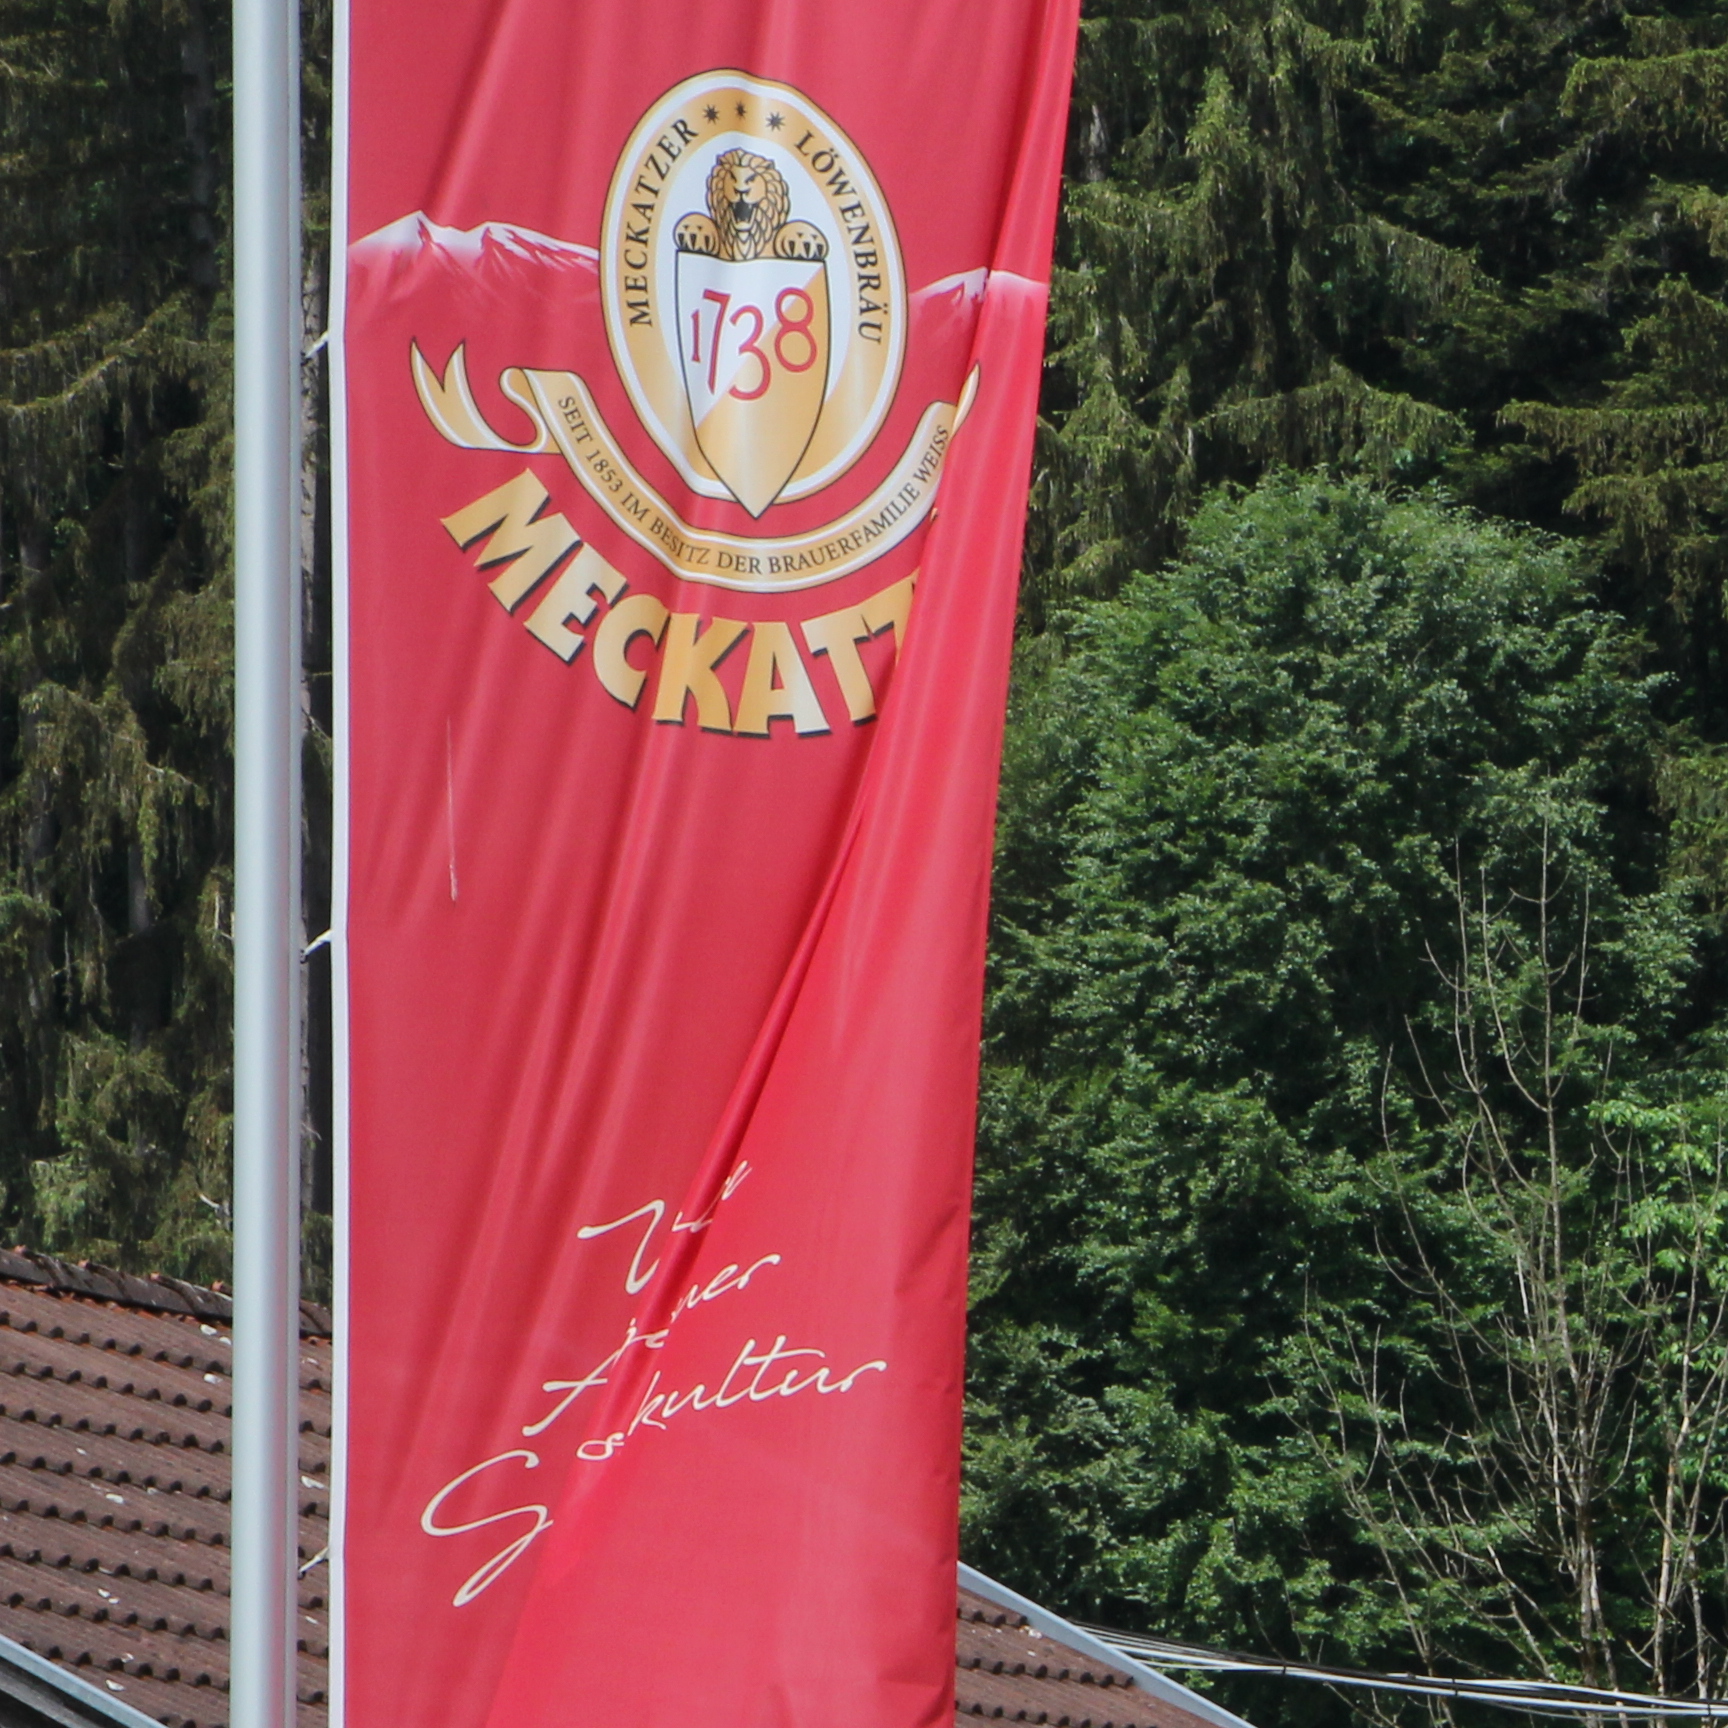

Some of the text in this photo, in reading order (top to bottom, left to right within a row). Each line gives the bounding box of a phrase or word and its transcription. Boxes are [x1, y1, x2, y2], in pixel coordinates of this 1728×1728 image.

[624, 118, 889, 344] MECKATZER LÖWENBRÄU
[690, 286, 818, 401] 1738
[557, 395, 950, 575] SEIT 1853 IM BESITZ DER BRAUERFAMILIE WEISS
